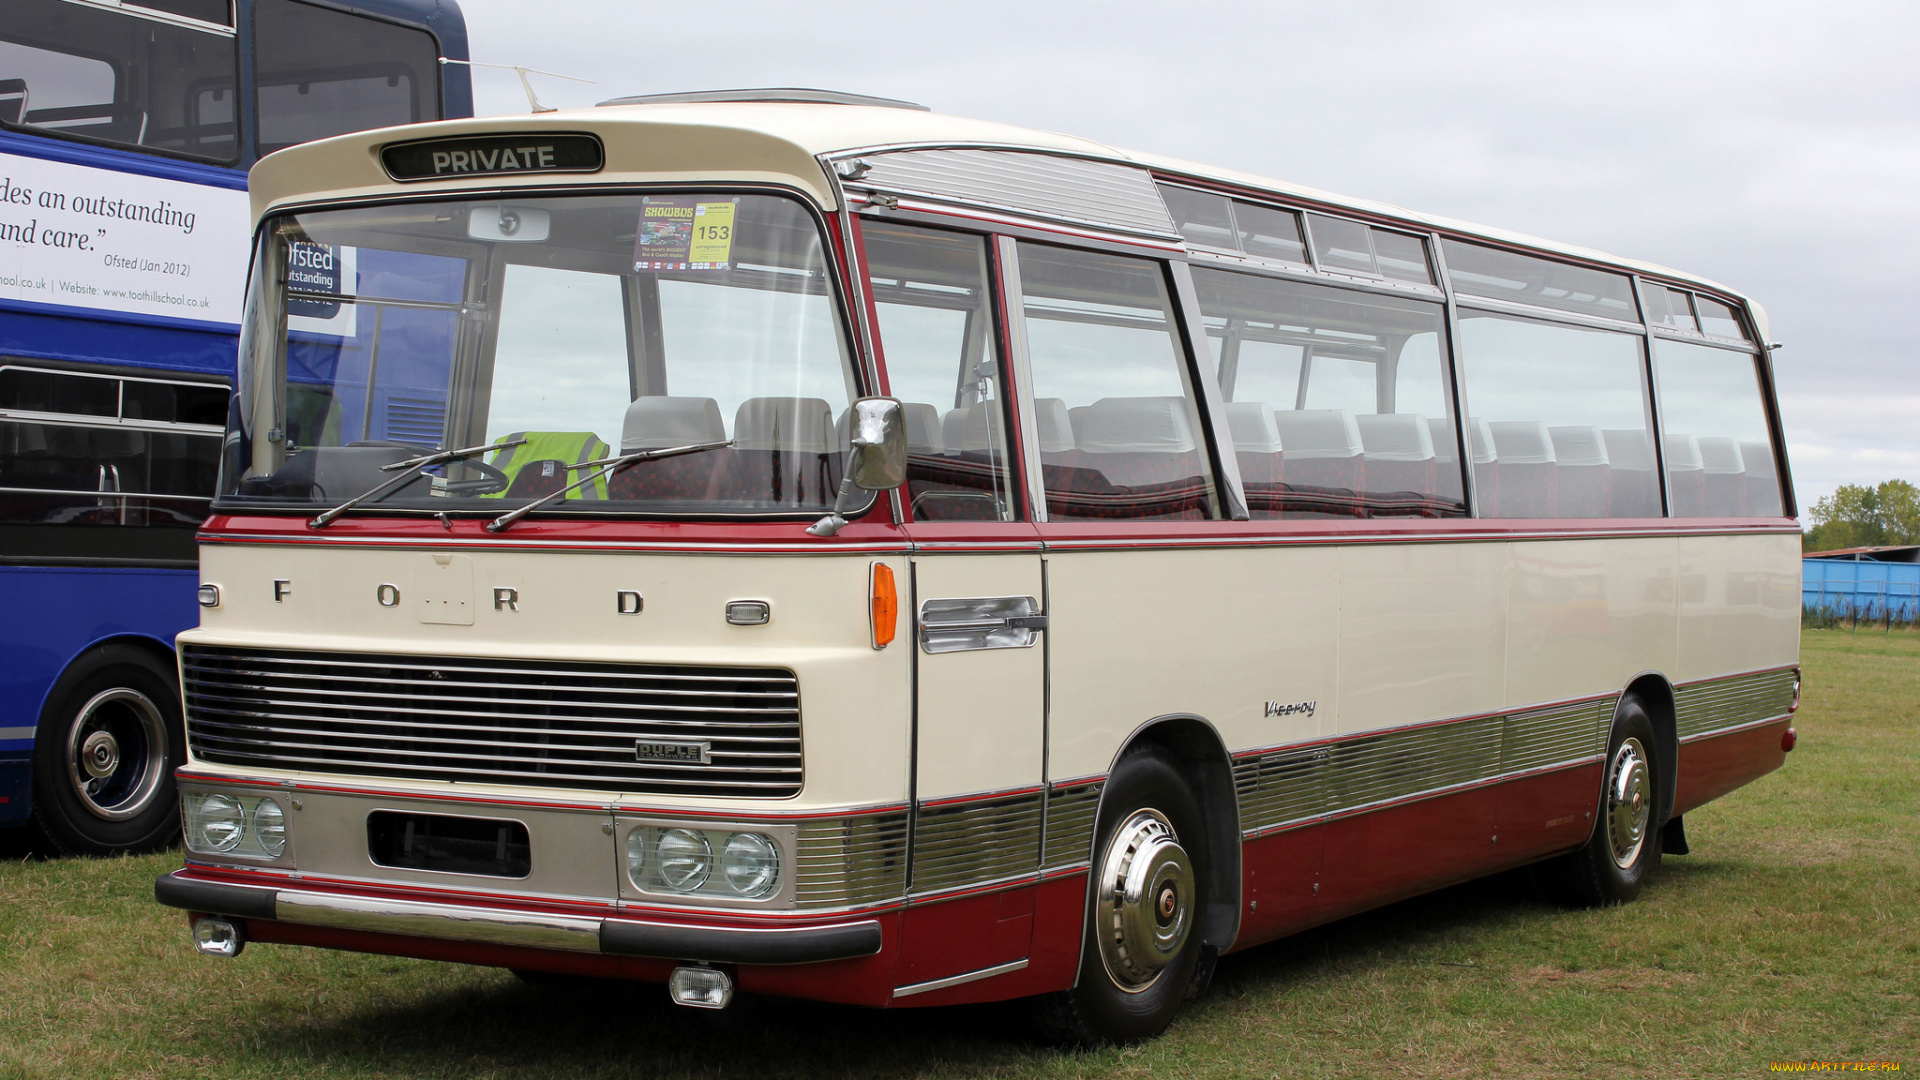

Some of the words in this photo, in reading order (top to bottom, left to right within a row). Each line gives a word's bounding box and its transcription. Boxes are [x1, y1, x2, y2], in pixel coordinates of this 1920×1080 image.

[432, 146, 556, 174] PRIVATE
[38, 191, 66, 210] an
[72, 196, 196, 234] outstanding
[644, 207, 694, 218] SHOWBUS
[698, 226, 730, 240] 153
[104, 254, 138, 270] Ofsted
[140, 259, 160, 272] (Jan
[163, 262, 191, 277] 2012)
[288, 242, 333, 270] fsted
[288, 270, 333, 289] utstanding
[59, 280, 100, 296] Website:
[102, 288, 210, 308] www.toothillschool.co.uk
[640, 745, 697, 755] DUPLE
